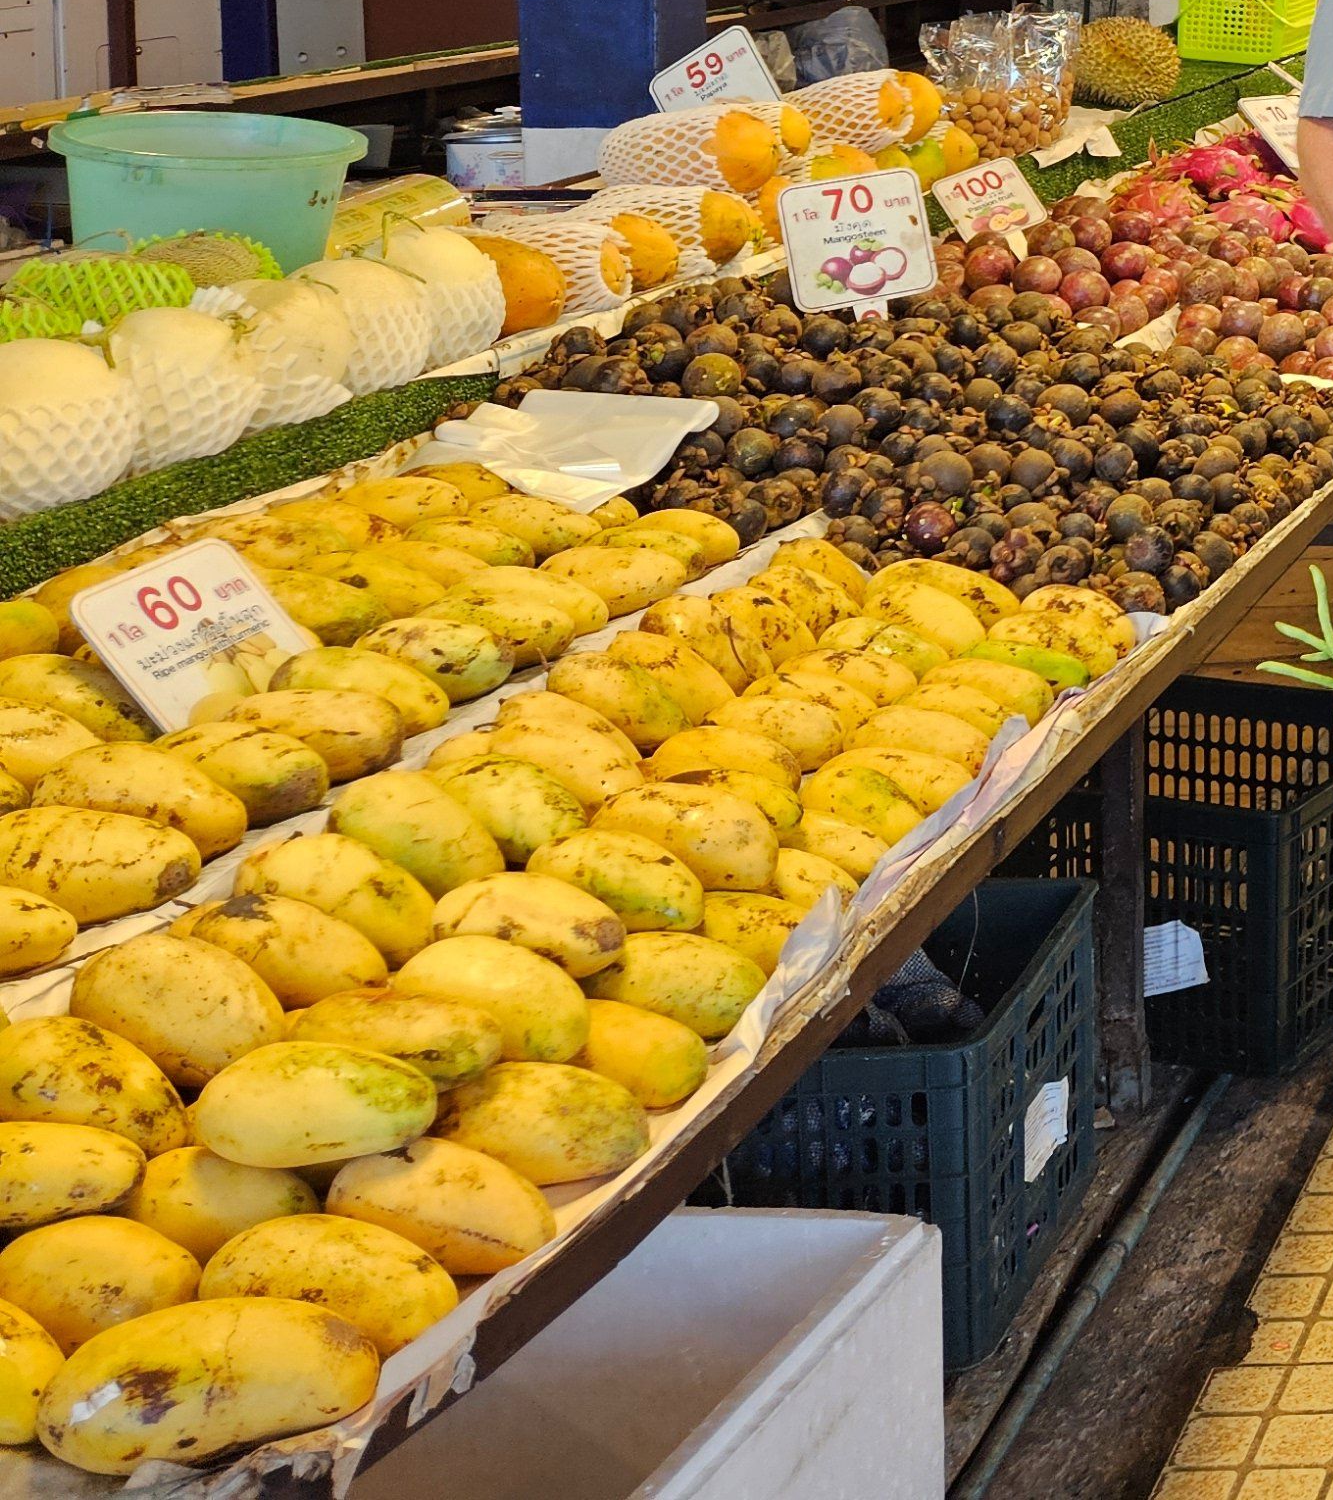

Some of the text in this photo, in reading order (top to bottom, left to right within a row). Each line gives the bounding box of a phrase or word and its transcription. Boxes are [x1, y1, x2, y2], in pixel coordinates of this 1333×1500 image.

[686, 52, 724, 89] 59
[701, 82, 728, 101] Papaya
[822, 184, 874, 221] 70
[884, 195, 911, 208] บาท
[953, 170, 1003, 202] 100
[968, 192, 1015, 213] Passion fruit
[823, 229, 887, 245] Mangosteen
[107, 575, 249, 647] 1 โล 60 บาท
[152, 619, 271, 681] Ripe mango with turmeric
